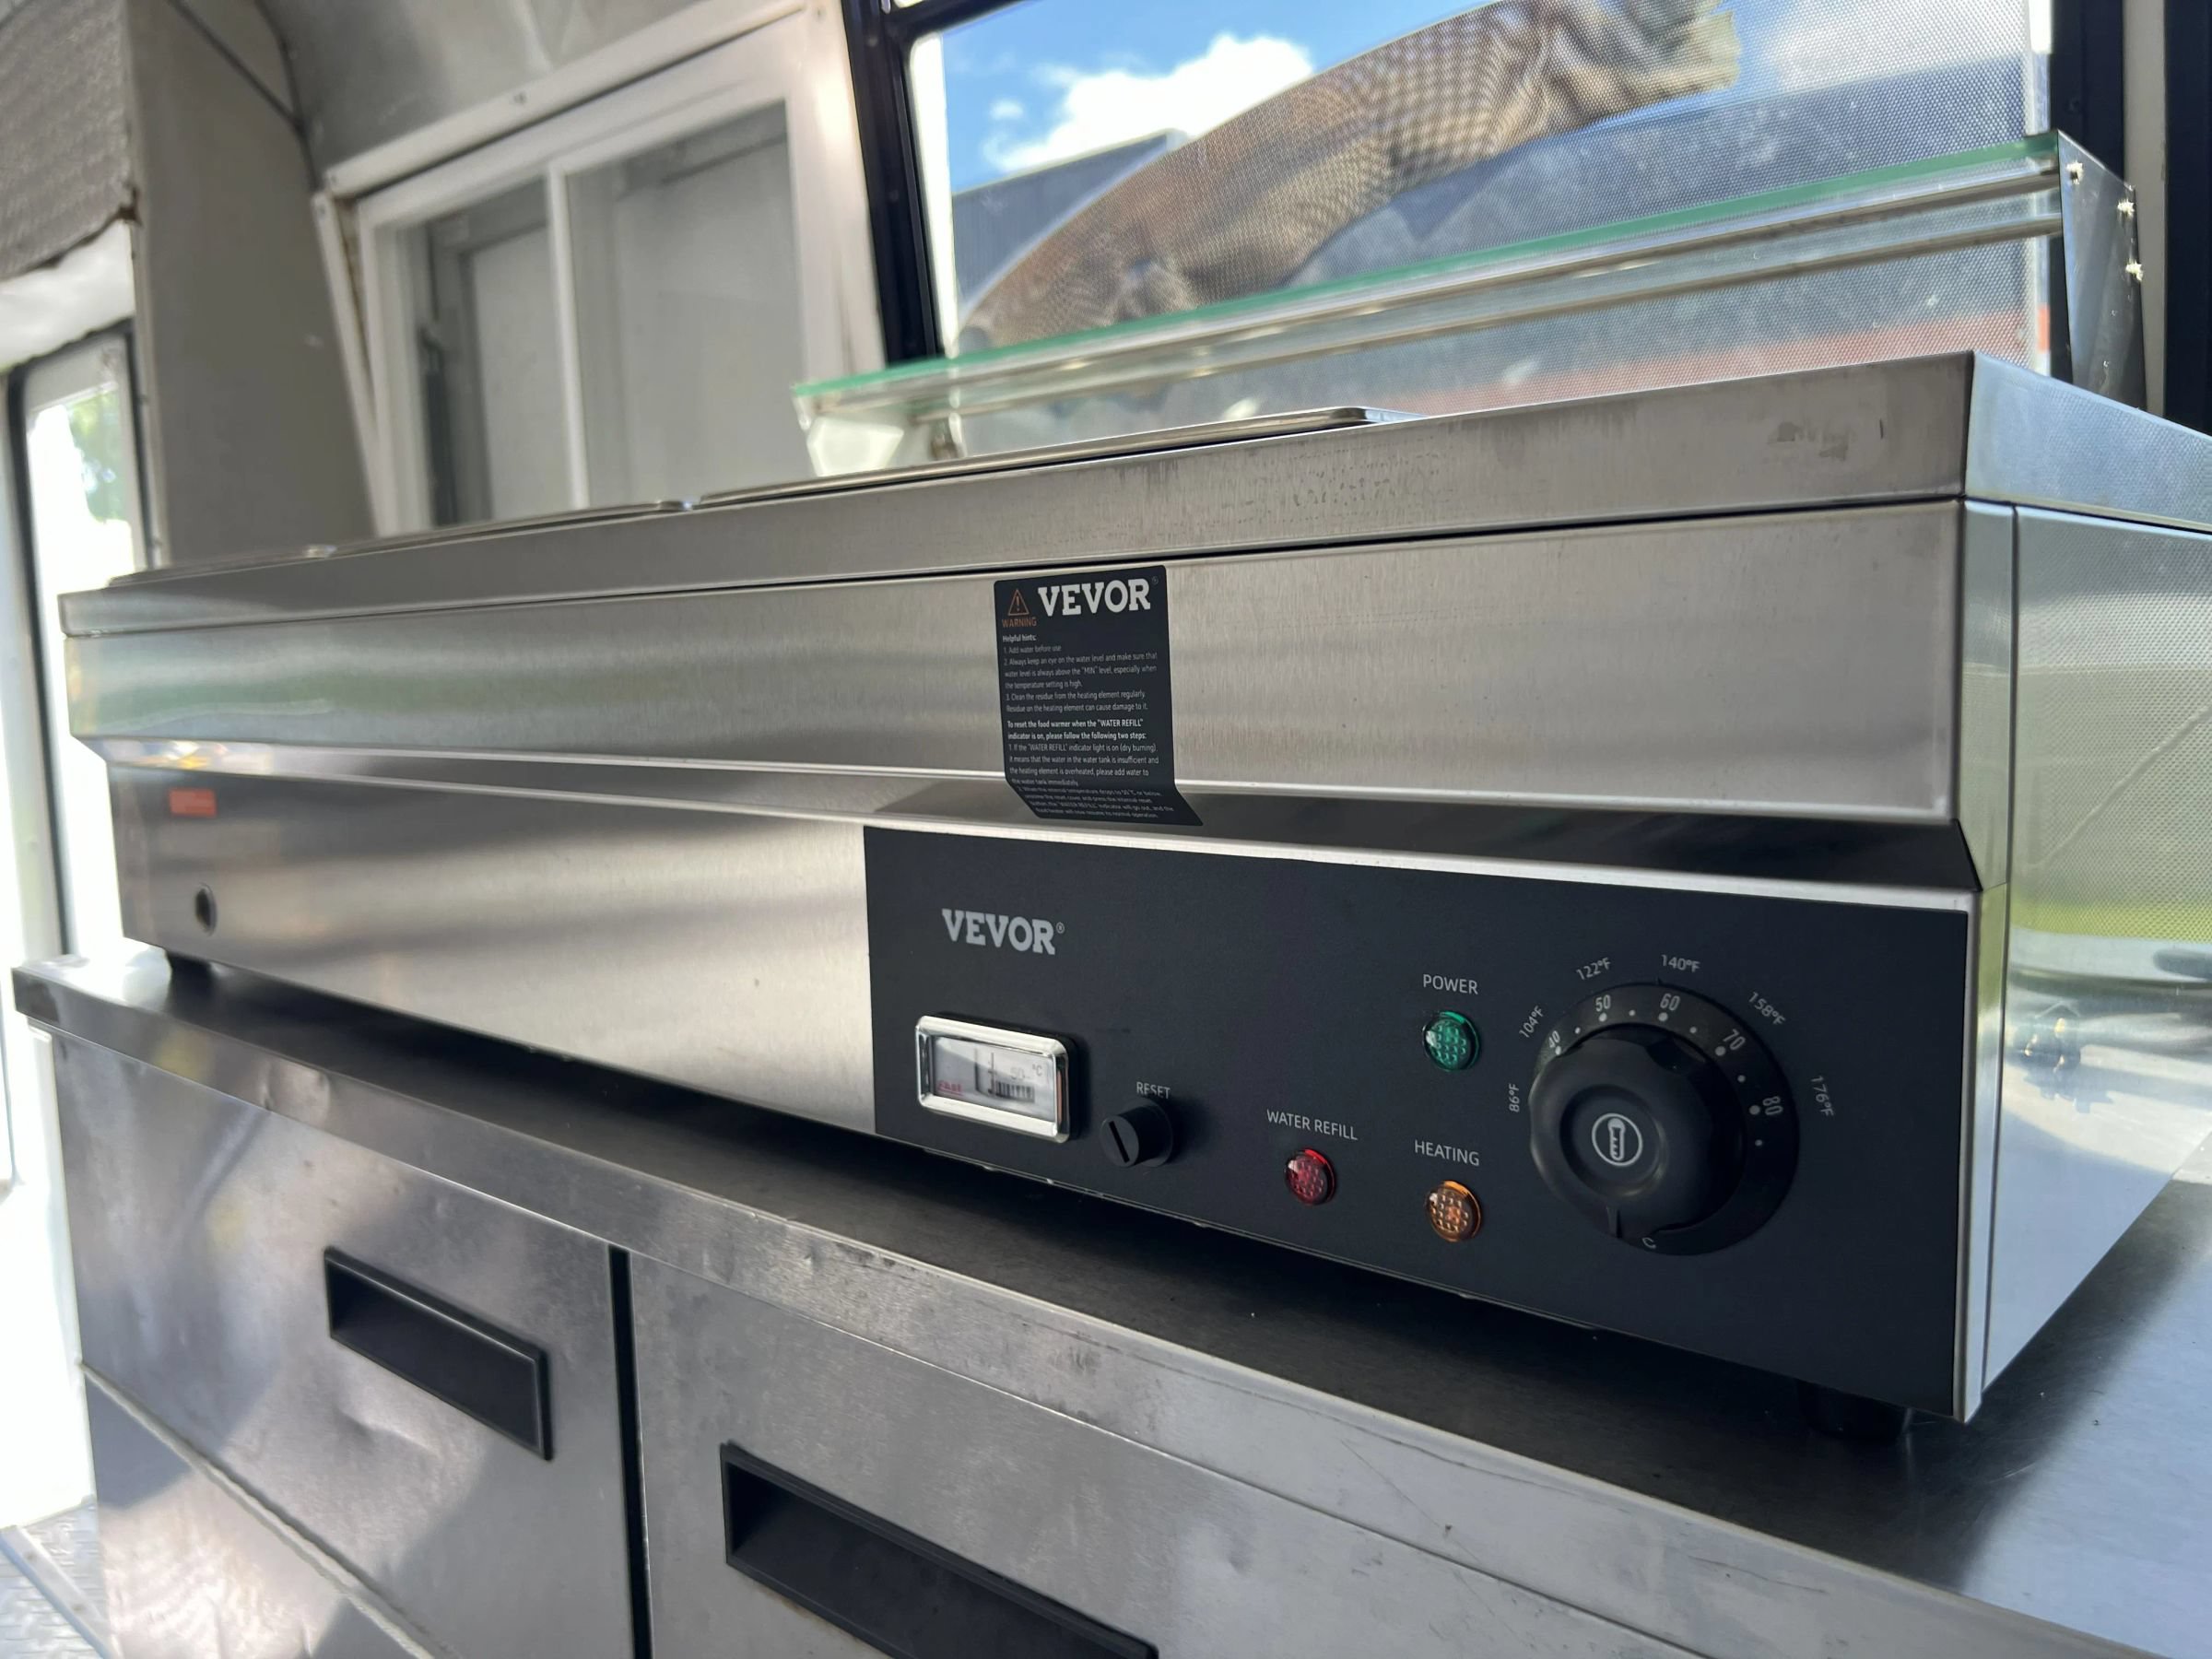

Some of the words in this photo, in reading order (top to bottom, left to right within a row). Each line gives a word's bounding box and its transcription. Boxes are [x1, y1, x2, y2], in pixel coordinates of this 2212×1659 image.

[1002, 617, 1037, 628] WARNING
[1003, 634, 1021, 643] Helpful
[1092, 653, 1104, 662] level
[1117, 652, 1132, 660] make
[1037, 669, 1053, 677] always
[1055, 667, 1070, 676] above
[1113, 665, 1140, 675] especially
[1077, 691, 1097, 700] heating
[1043, 704, 1063, 713] heating
[1112, 703, 1135, 712] damage
[1122, 718, 1143, 726] REFILL"
[1046, 732, 1063, 741] please
[1091, 732, 1116, 740] following
[1093, 744, 1105, 753] light
[1120, 743, 1131, 753] (dry
[1018, 768, 1038, 776] heating
[1096, 768, 1112, 778] please
[1576, 958, 1611, 981] 122°F
[1661, 954, 1700, 972] 140°F
[1423, 974, 1478, 994] POWER
[1595, 994, 1611, 1012] 50
[1660, 993, 1680, 1011] 60
[1748, 991, 1785, 1026] 158°F
[1519, 1006, 1544, 1039] 104°F
[1724, 1029, 1746, 1051] 70
[1136, 1081, 1171, 1099] RESET
[1508, 1083, 1520, 1112] 86°F
[1811, 1076, 1834, 1117] 176°F
[1762, 1096, 1783, 1116] 80
[1266, 1109, 1311, 1131] WATER
[1314, 1118, 1358, 1141] REFILL
[1415, 1139, 1480, 1166] HEATING
